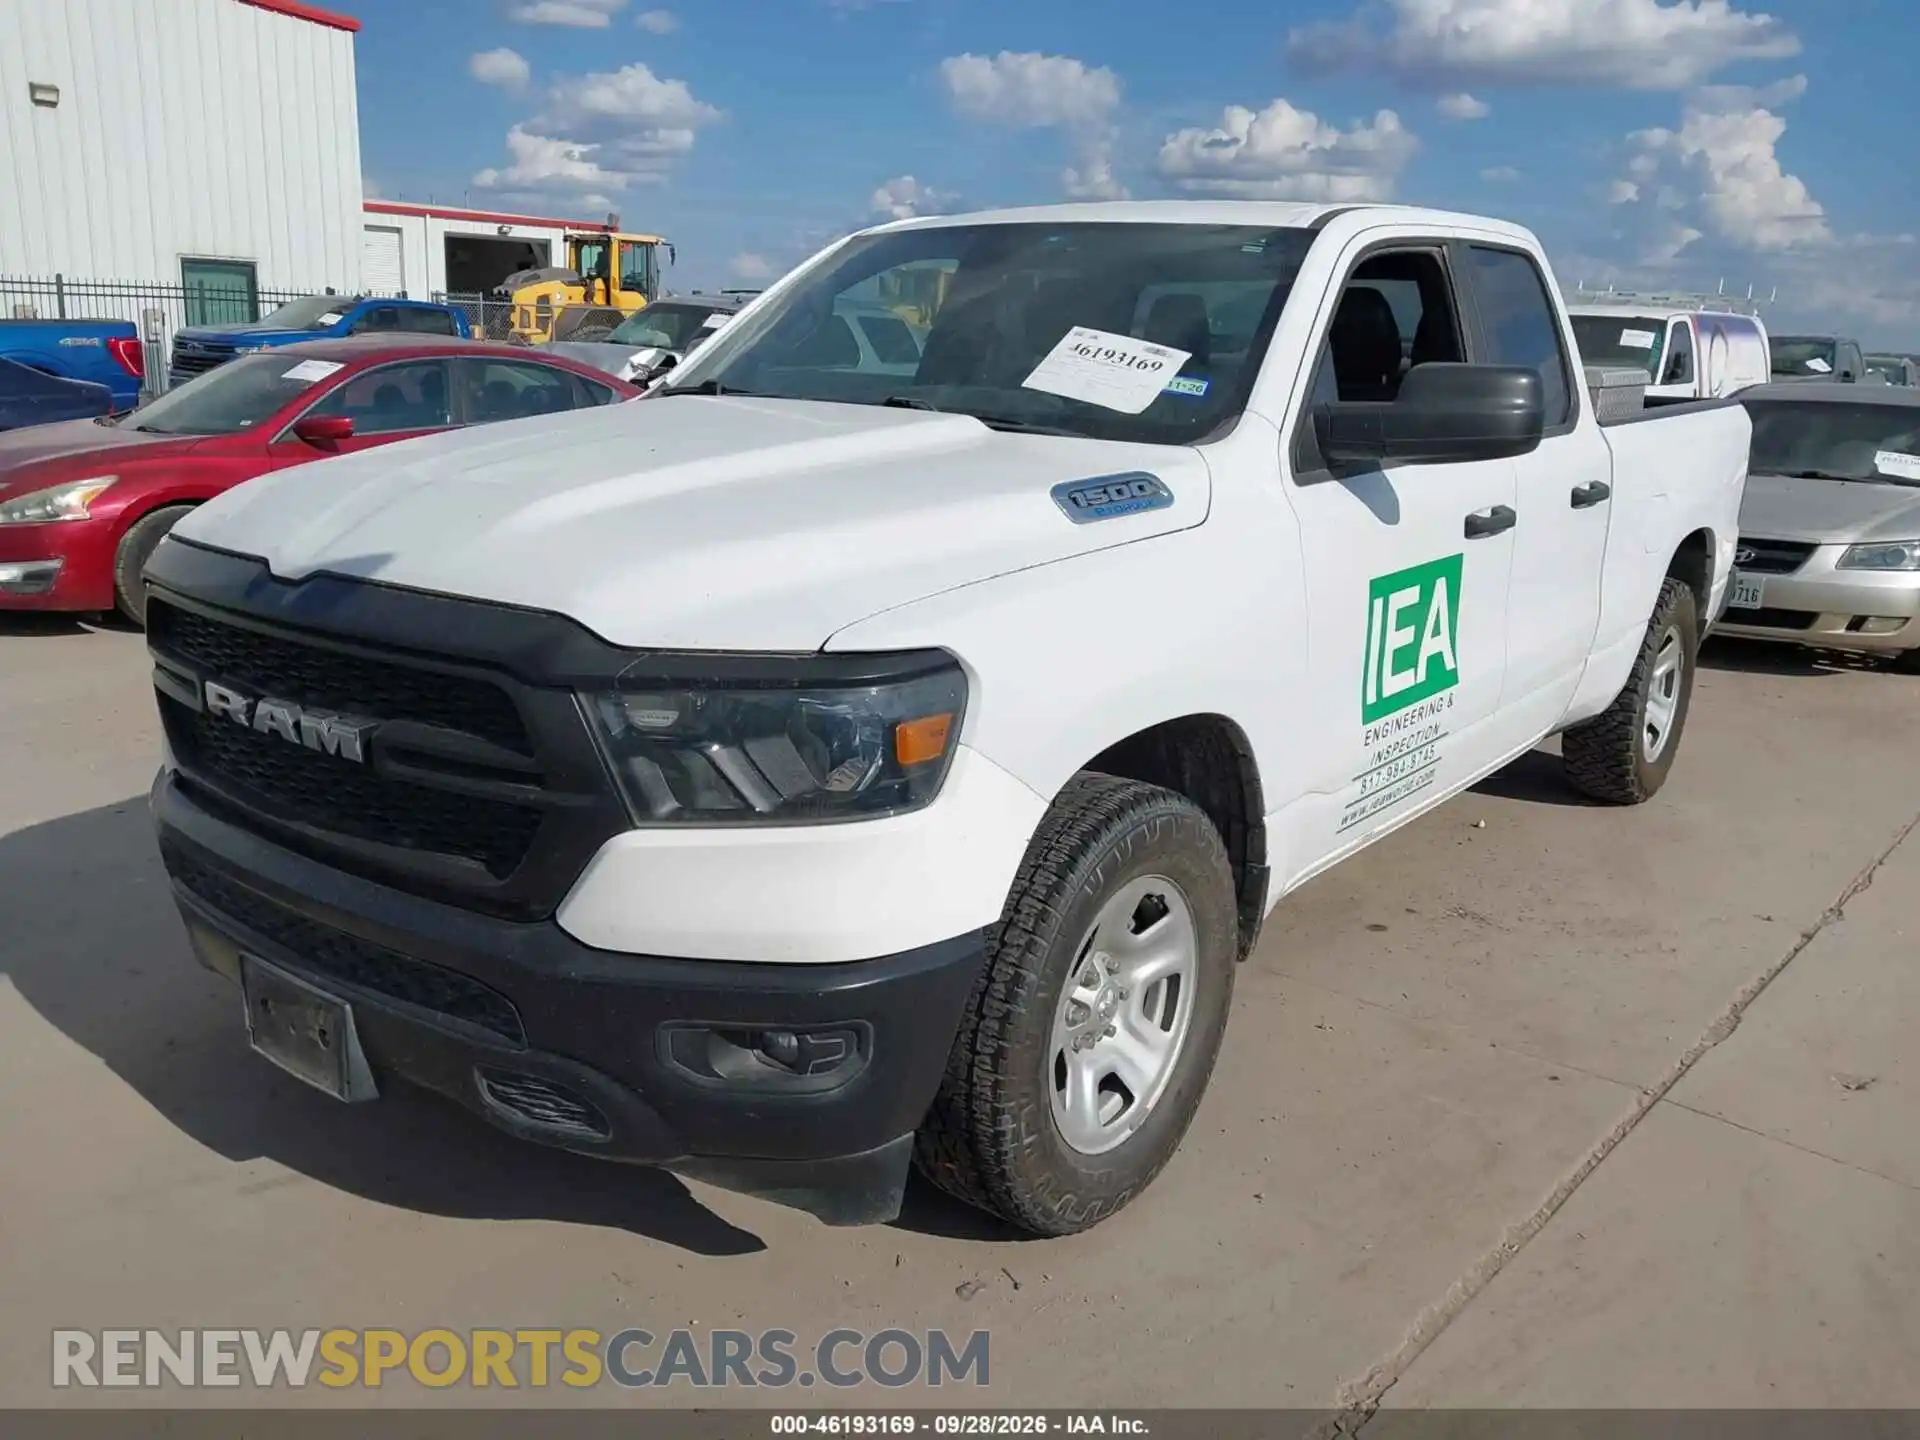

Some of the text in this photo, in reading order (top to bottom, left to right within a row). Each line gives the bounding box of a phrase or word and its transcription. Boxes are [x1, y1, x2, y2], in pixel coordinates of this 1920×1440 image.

[1068, 480, 1156, 508] 1500
[1366, 576, 1456, 705] IEA
[204, 681, 379, 764] RAM
[1364, 692, 1454, 747] ENGINEERING &
[1369, 722, 1441, 768] INSPECTION
